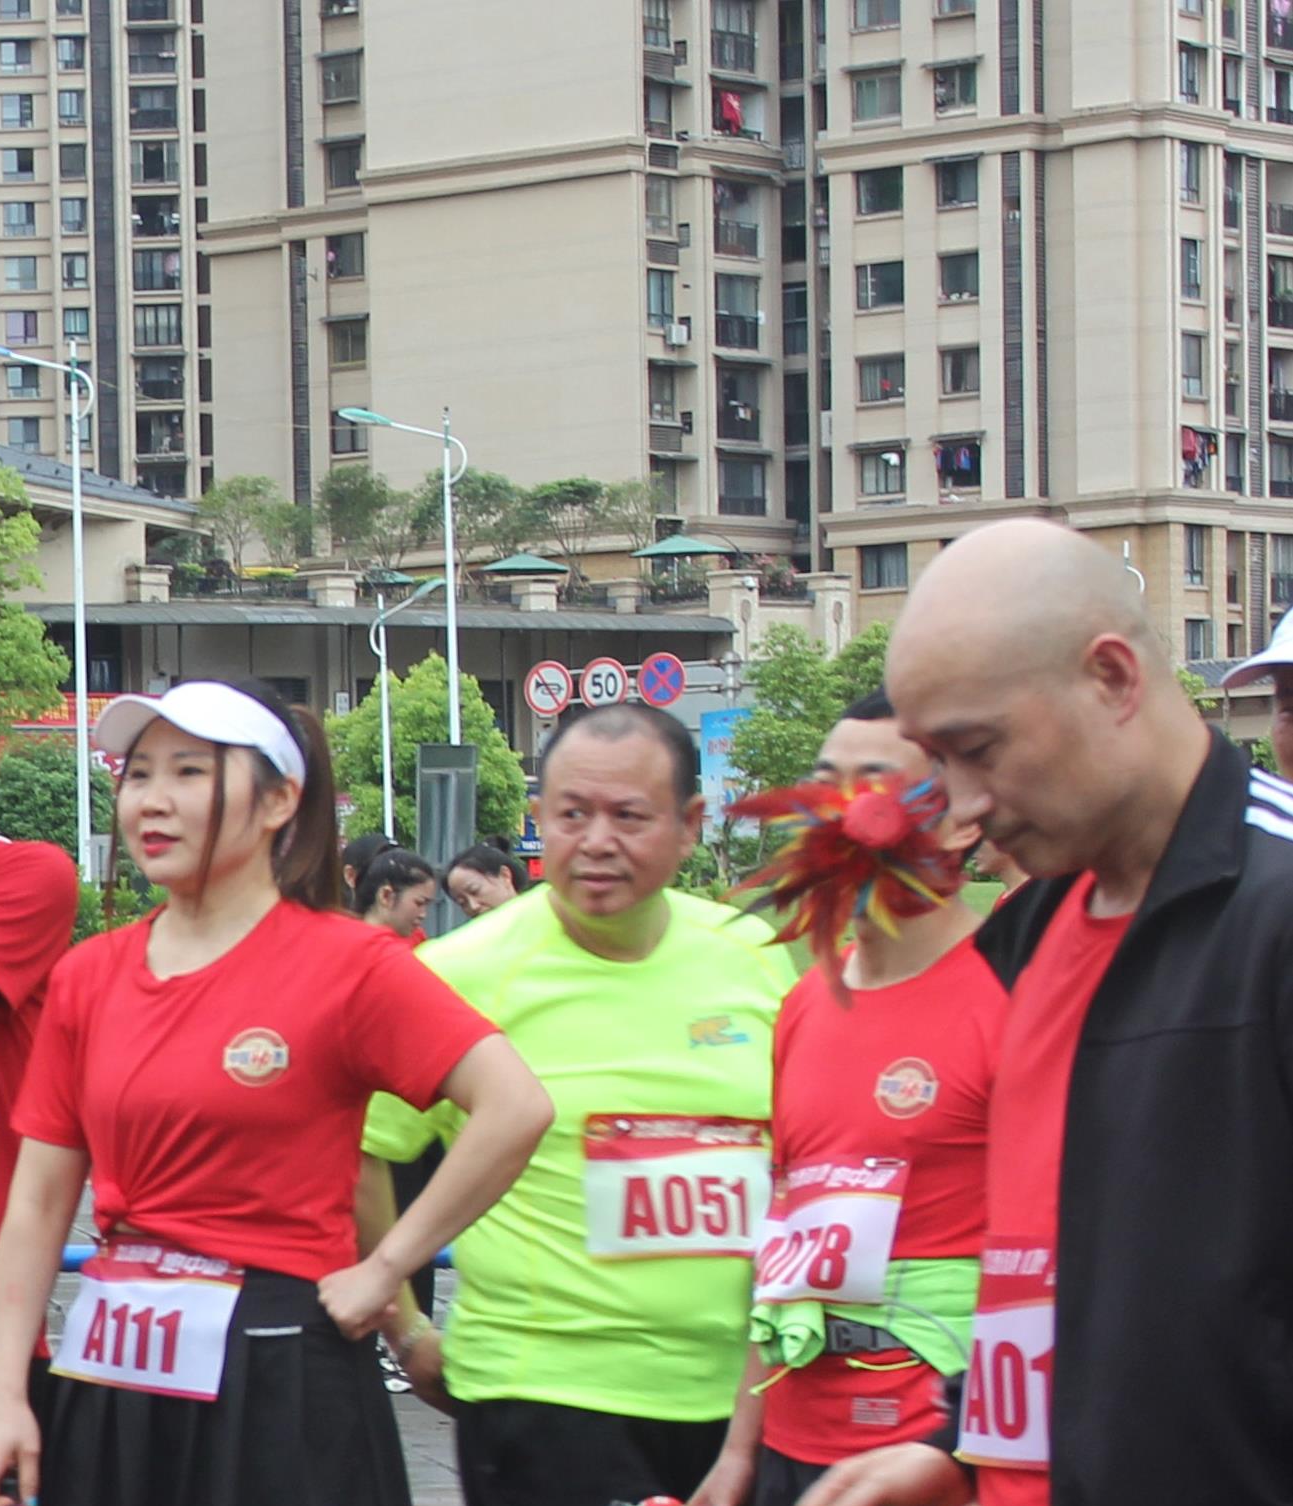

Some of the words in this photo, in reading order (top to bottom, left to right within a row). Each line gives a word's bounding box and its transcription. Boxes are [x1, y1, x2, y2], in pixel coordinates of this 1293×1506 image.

[592, 673, 618, 698] 50
[621, 1175, 749, 1238] A051
[82, 1298, 183, 1374] A111
